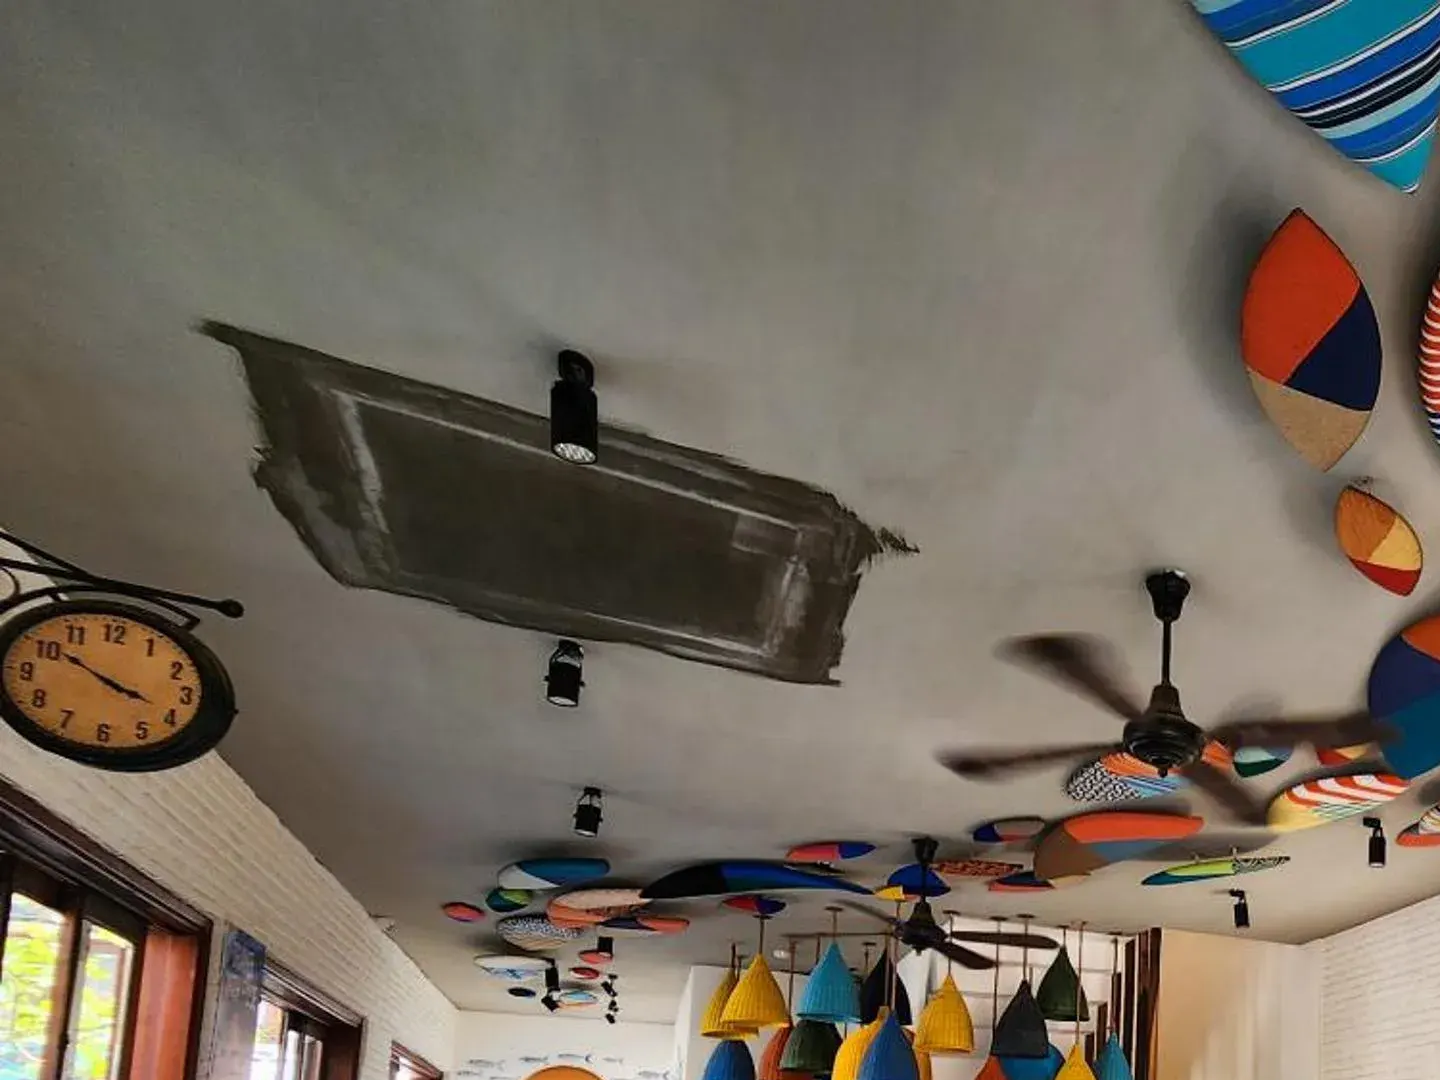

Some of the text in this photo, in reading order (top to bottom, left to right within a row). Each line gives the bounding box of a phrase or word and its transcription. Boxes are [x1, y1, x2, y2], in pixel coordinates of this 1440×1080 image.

[65, 624, 85, 645] 11
[103, 623, 127, 645] 12
[35, 640, 60, 661] 10
[146, 638, 155, 657] 1
[19, 661, 33, 681] 9
[170, 661, 184, 680] 2
[32, 689, 47, 708] 8
[180, 686, 193, 705] 3
[60, 709, 74, 729] 7
[163, 708, 176, 727] 4
[97, 723, 111, 743] 6
[135, 722, 149, 740] 5
